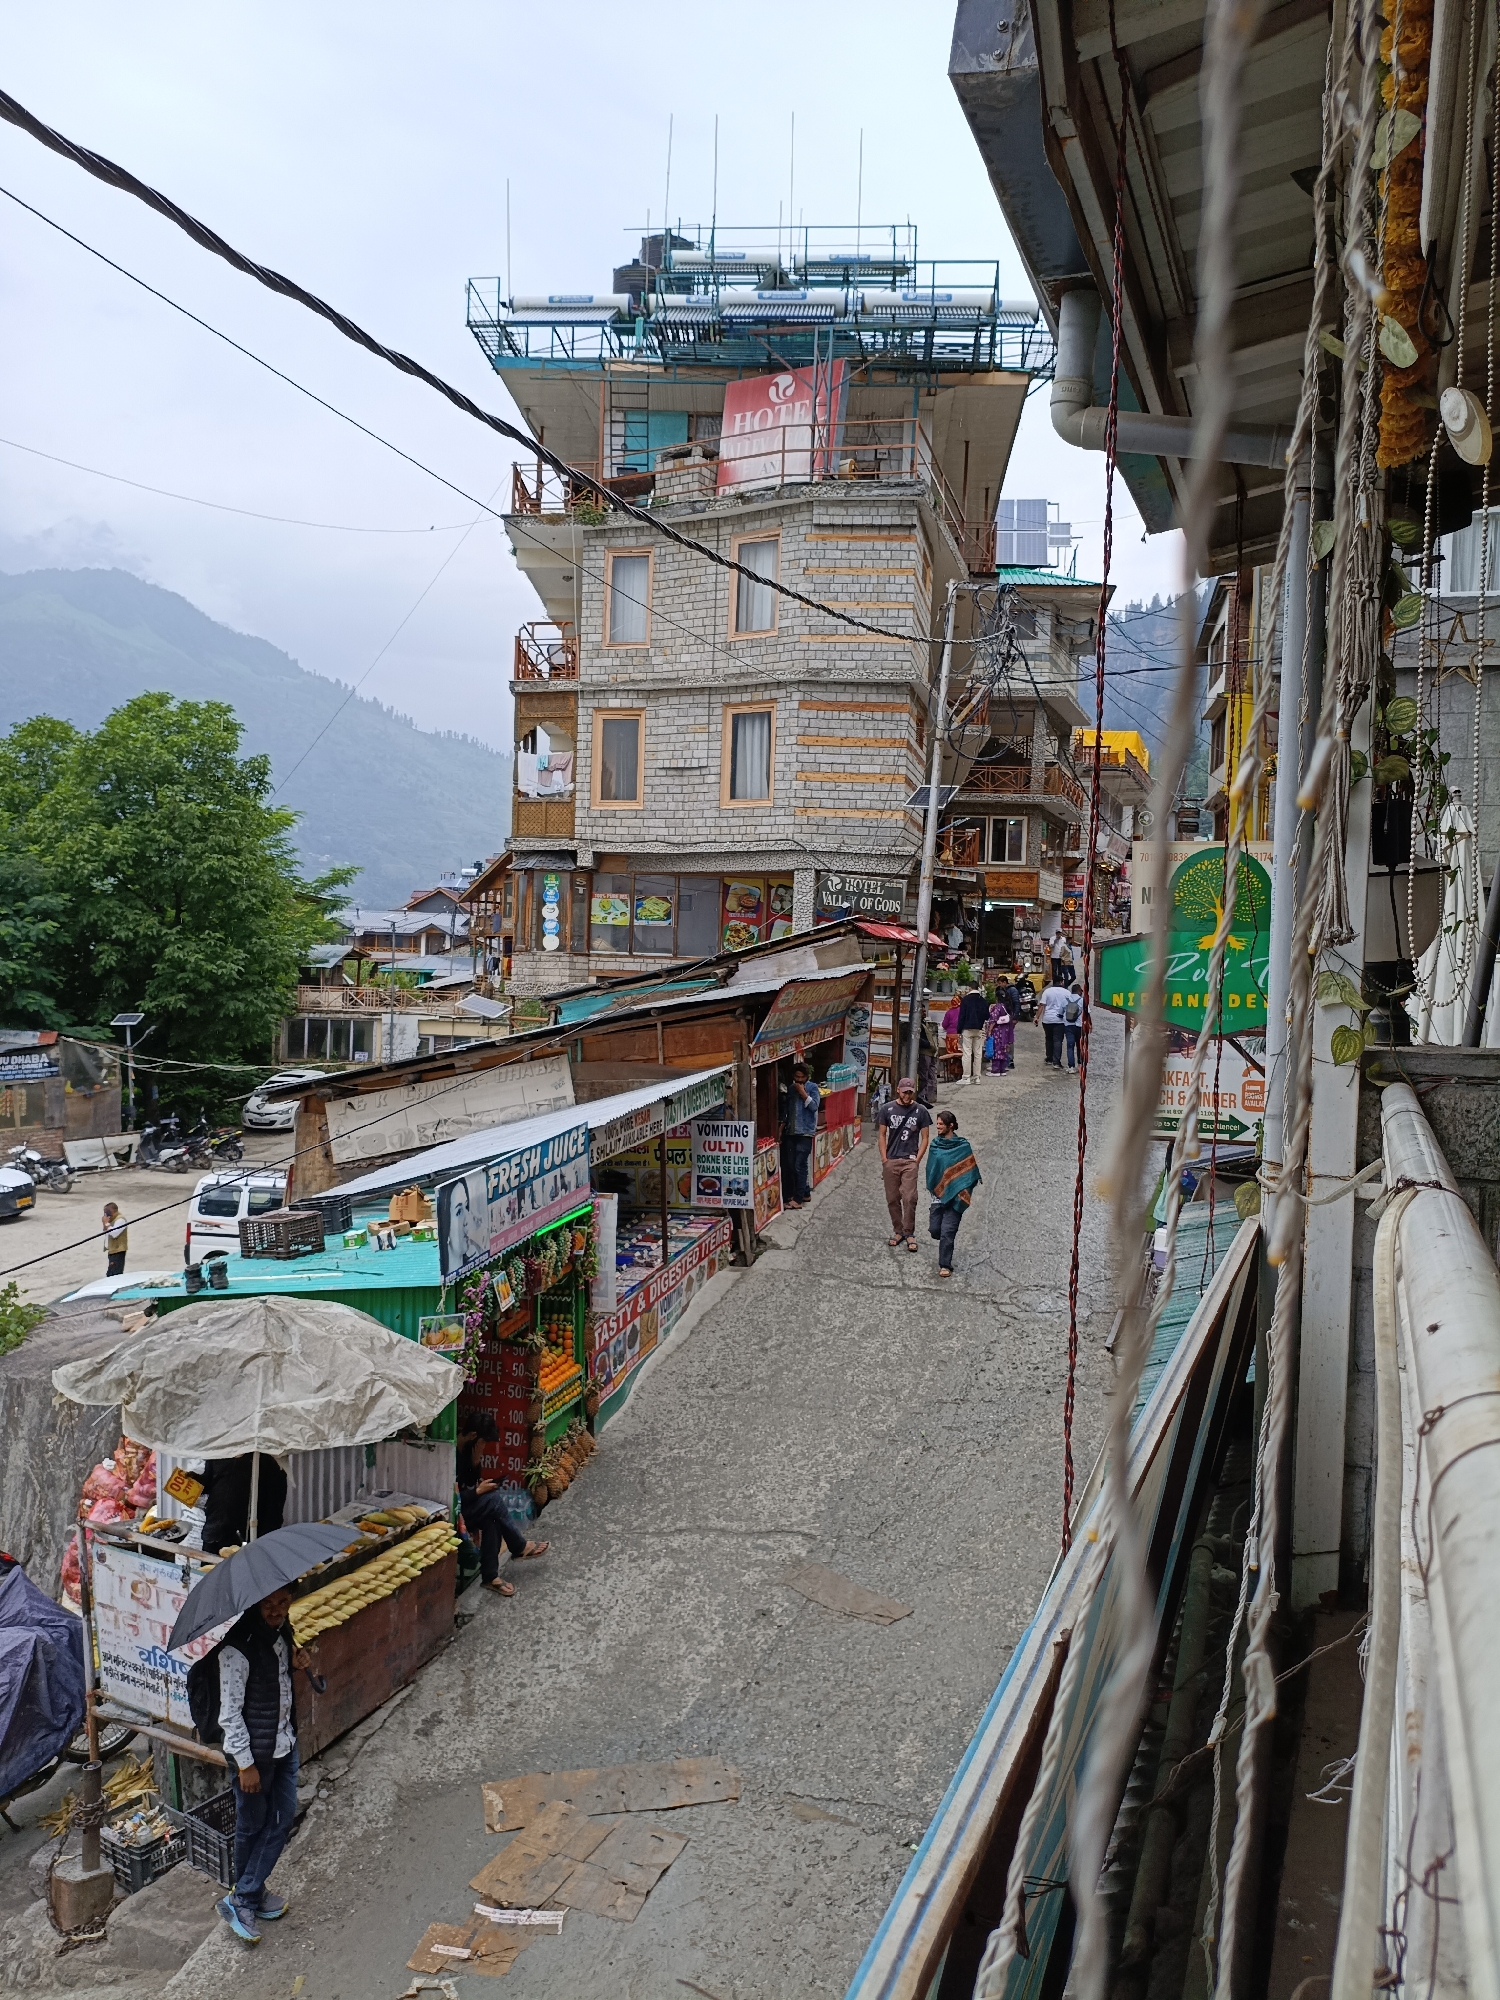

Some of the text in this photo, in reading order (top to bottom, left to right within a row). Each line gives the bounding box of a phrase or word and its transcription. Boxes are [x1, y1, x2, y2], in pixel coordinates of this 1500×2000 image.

[845, 878, 885, 895] HOTEL
[860, 897, 874, 909] OF
[875, 897, 900, 912] GODS
[11, 1053, 49, 1064] DHABA
[604, 1122, 619, 1142] 100%
[620, 1115, 634, 1135] PURE
[649, 1119, 663, 1137] HERE
[697, 1124, 749, 1138] VOMITING
[901, 1130, 909, 1141] 3
[703, 1140, 744, 1153] (ULTI)
[487, 1125, 587, 1199] FRESH JUICE
[696, 1154, 749, 1166] ROKNE KE LIYE
[697, 1165, 749, 1175] YAHAN SE LEIN
[594, 1302, 633, 1350] TASTY
[636, 1291, 647, 1313] &
[649, 1249, 700, 1303] DIGESTED
[701, 1223, 730, 1259] ITEMS
